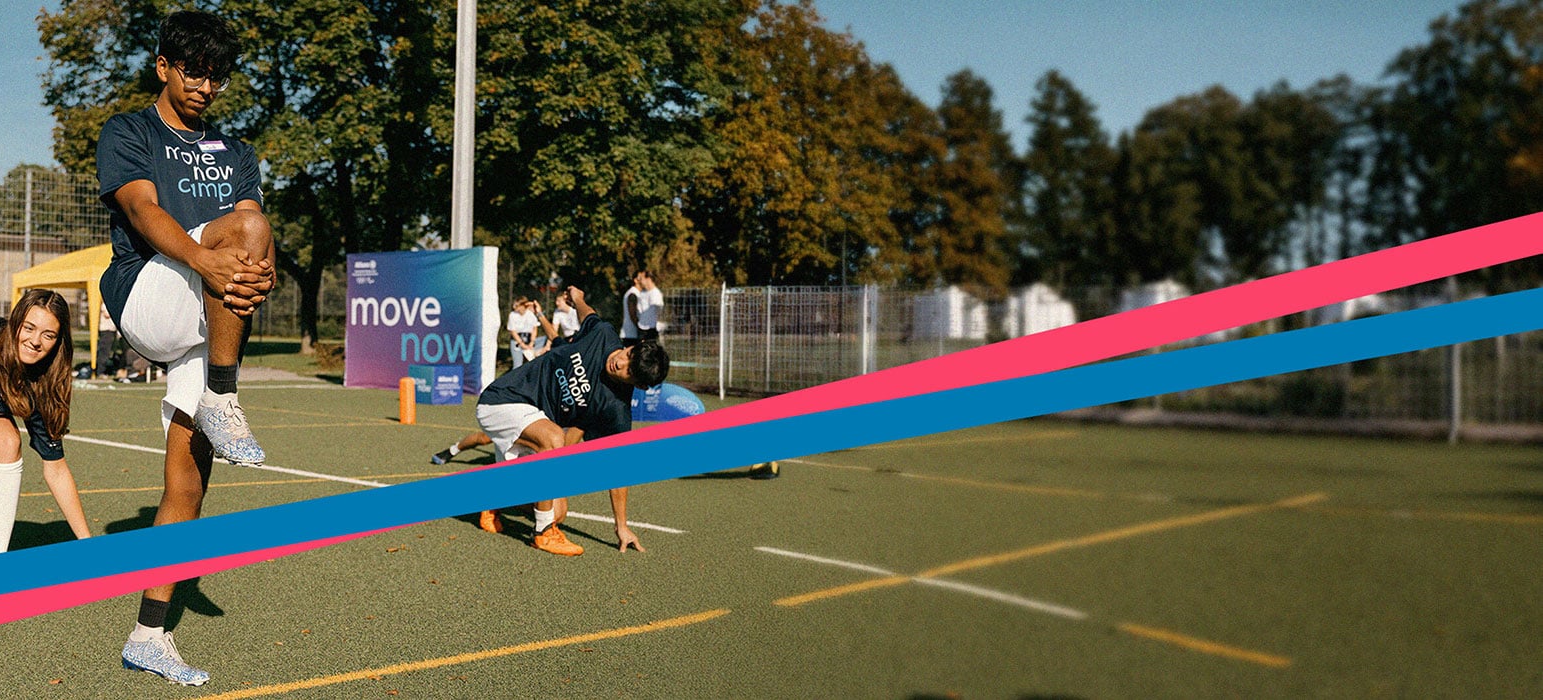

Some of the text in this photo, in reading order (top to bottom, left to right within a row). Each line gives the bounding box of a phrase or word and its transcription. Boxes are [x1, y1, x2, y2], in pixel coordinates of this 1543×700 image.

[351, 296, 441, 327] move
[401, 332, 476, 364] now
[555, 368, 575, 406] camp
[569, 352, 591, 394] move
[568, 376, 588, 407] now
